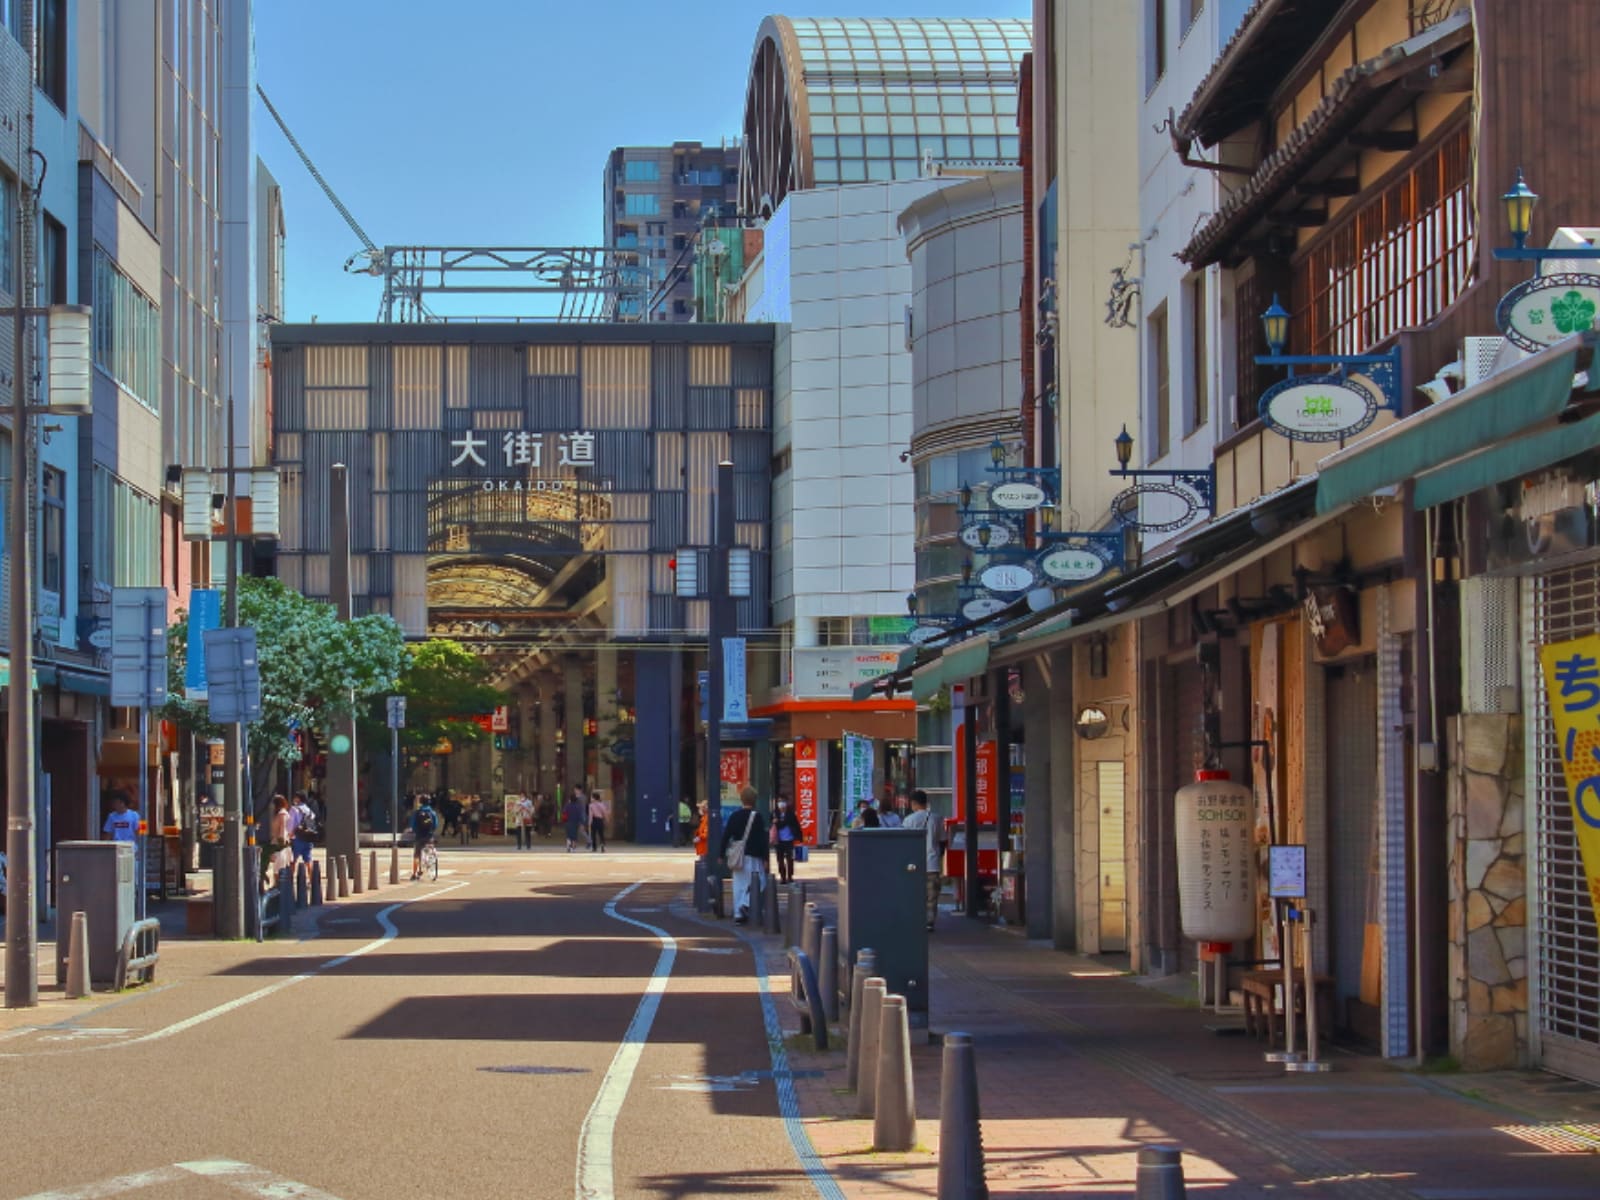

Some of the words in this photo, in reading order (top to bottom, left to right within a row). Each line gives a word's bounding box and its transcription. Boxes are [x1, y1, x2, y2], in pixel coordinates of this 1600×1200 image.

[450, 430, 595, 467] 大街道
[482, 480, 562, 492] OKAIDO
[799, 788, 815, 829] カラオケ
